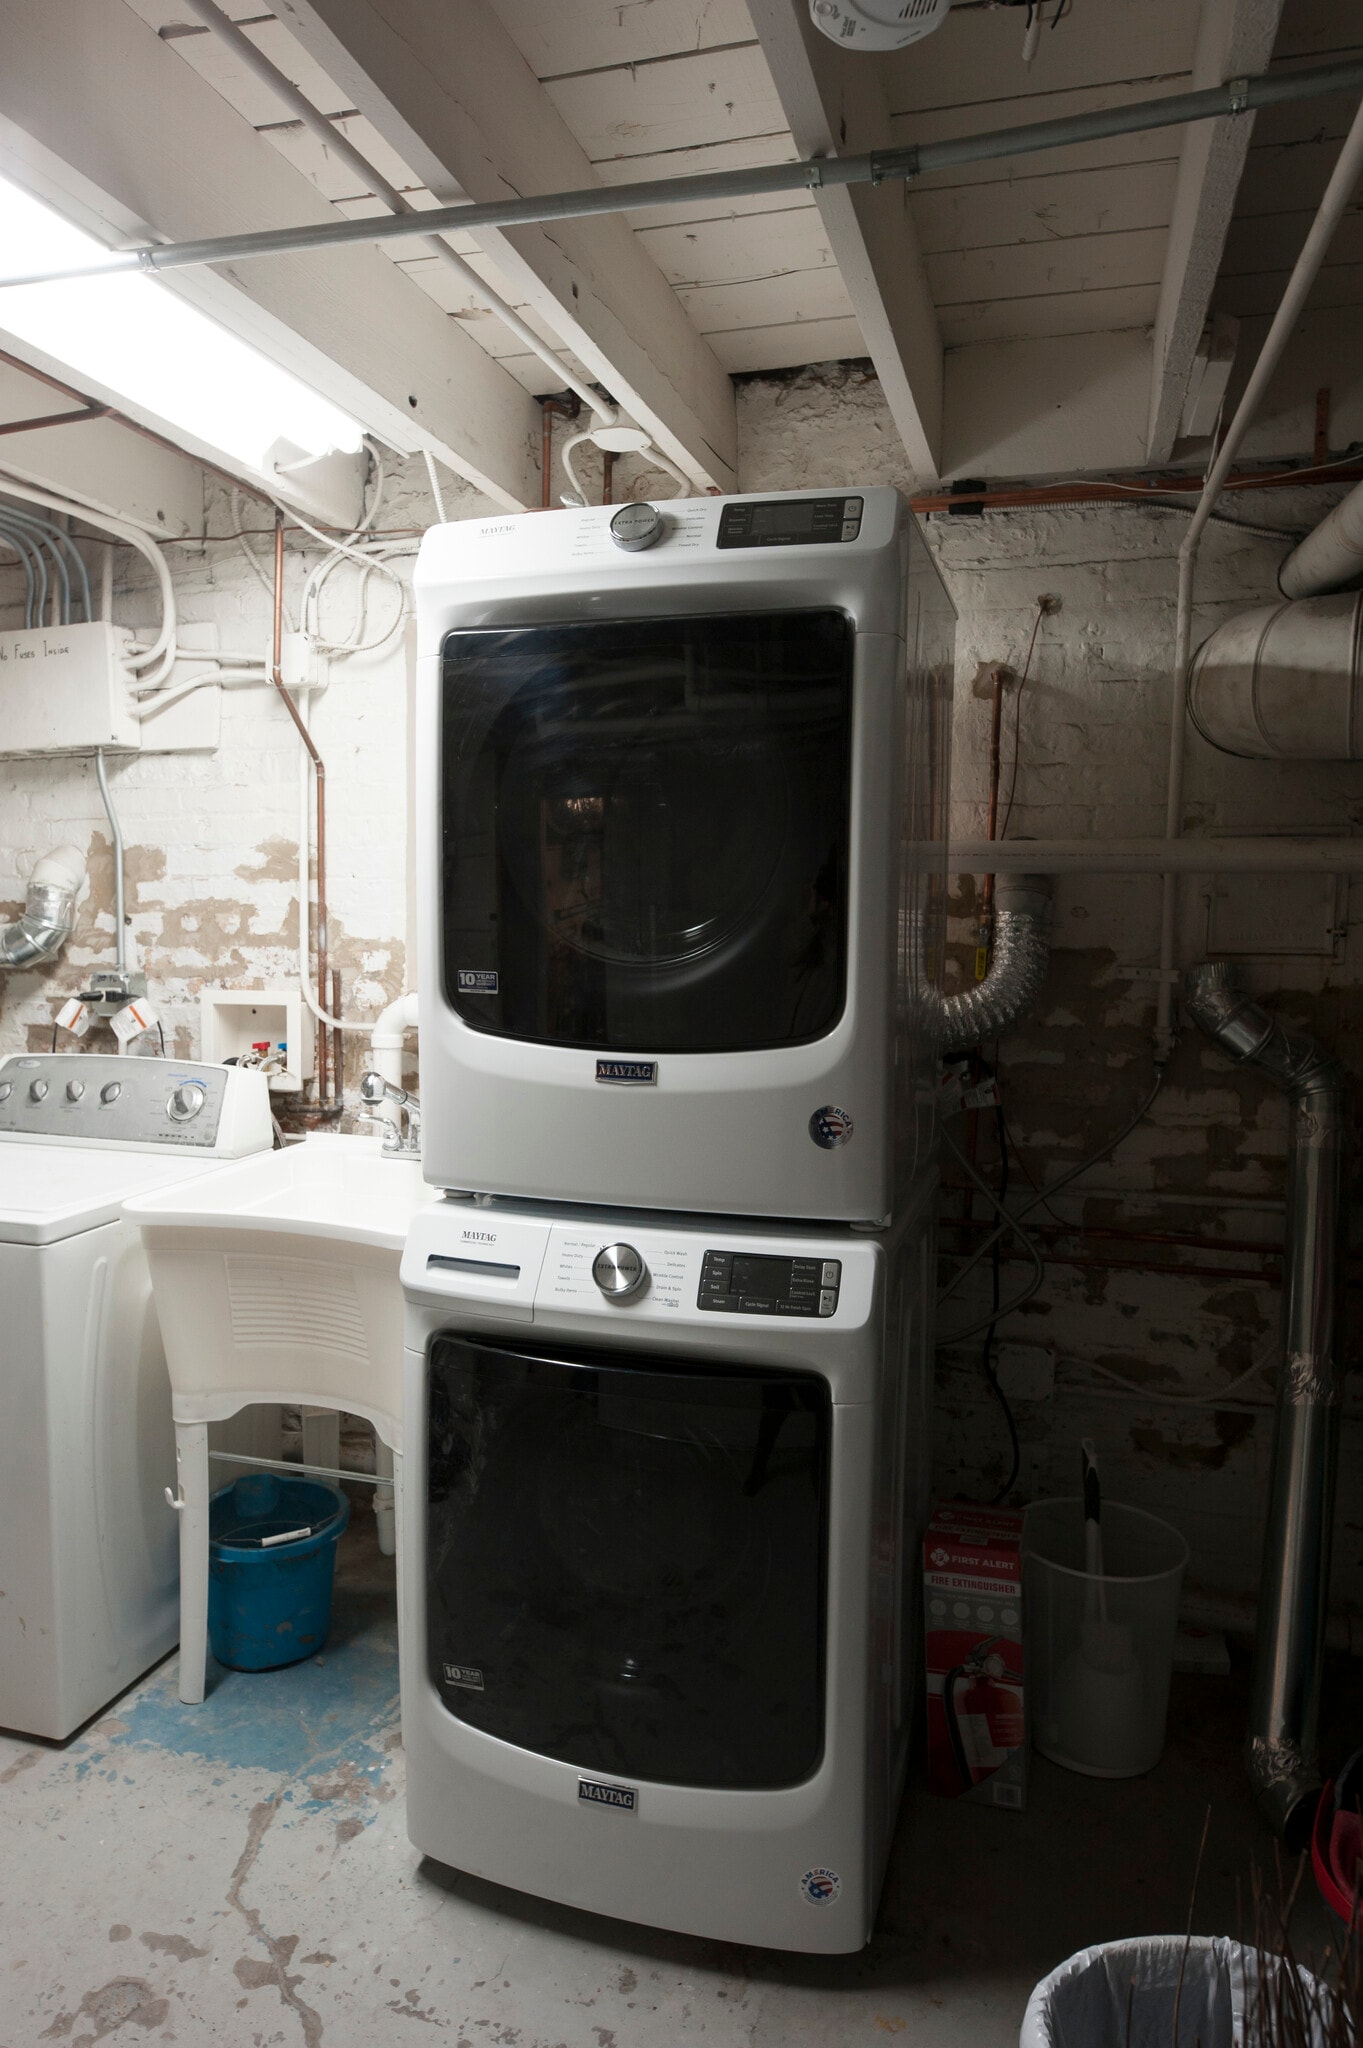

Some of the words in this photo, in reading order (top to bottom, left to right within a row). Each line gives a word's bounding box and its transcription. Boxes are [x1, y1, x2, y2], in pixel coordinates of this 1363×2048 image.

[460, 973, 475, 985] 10
[598, 1064, 651, 1077] MAYTAG
[814, 1107, 852, 1128] AMERICA
[462, 1230, 497, 1242] MAYTAG
[952, 1555, 980, 1565] FIRST
[982, 1560, 1015, 1570] ALERT
[931, 1575, 950, 1586] FIRE
[952, 1578, 1016, 1594] EXTINGUISHER
[446, 1666, 461, 1679] 10
[461, 1669, 480, 1677] YEAR
[580, 1784, 632, 1806] MAYTAG
[802, 1869, 839, 1885] AMERICA
